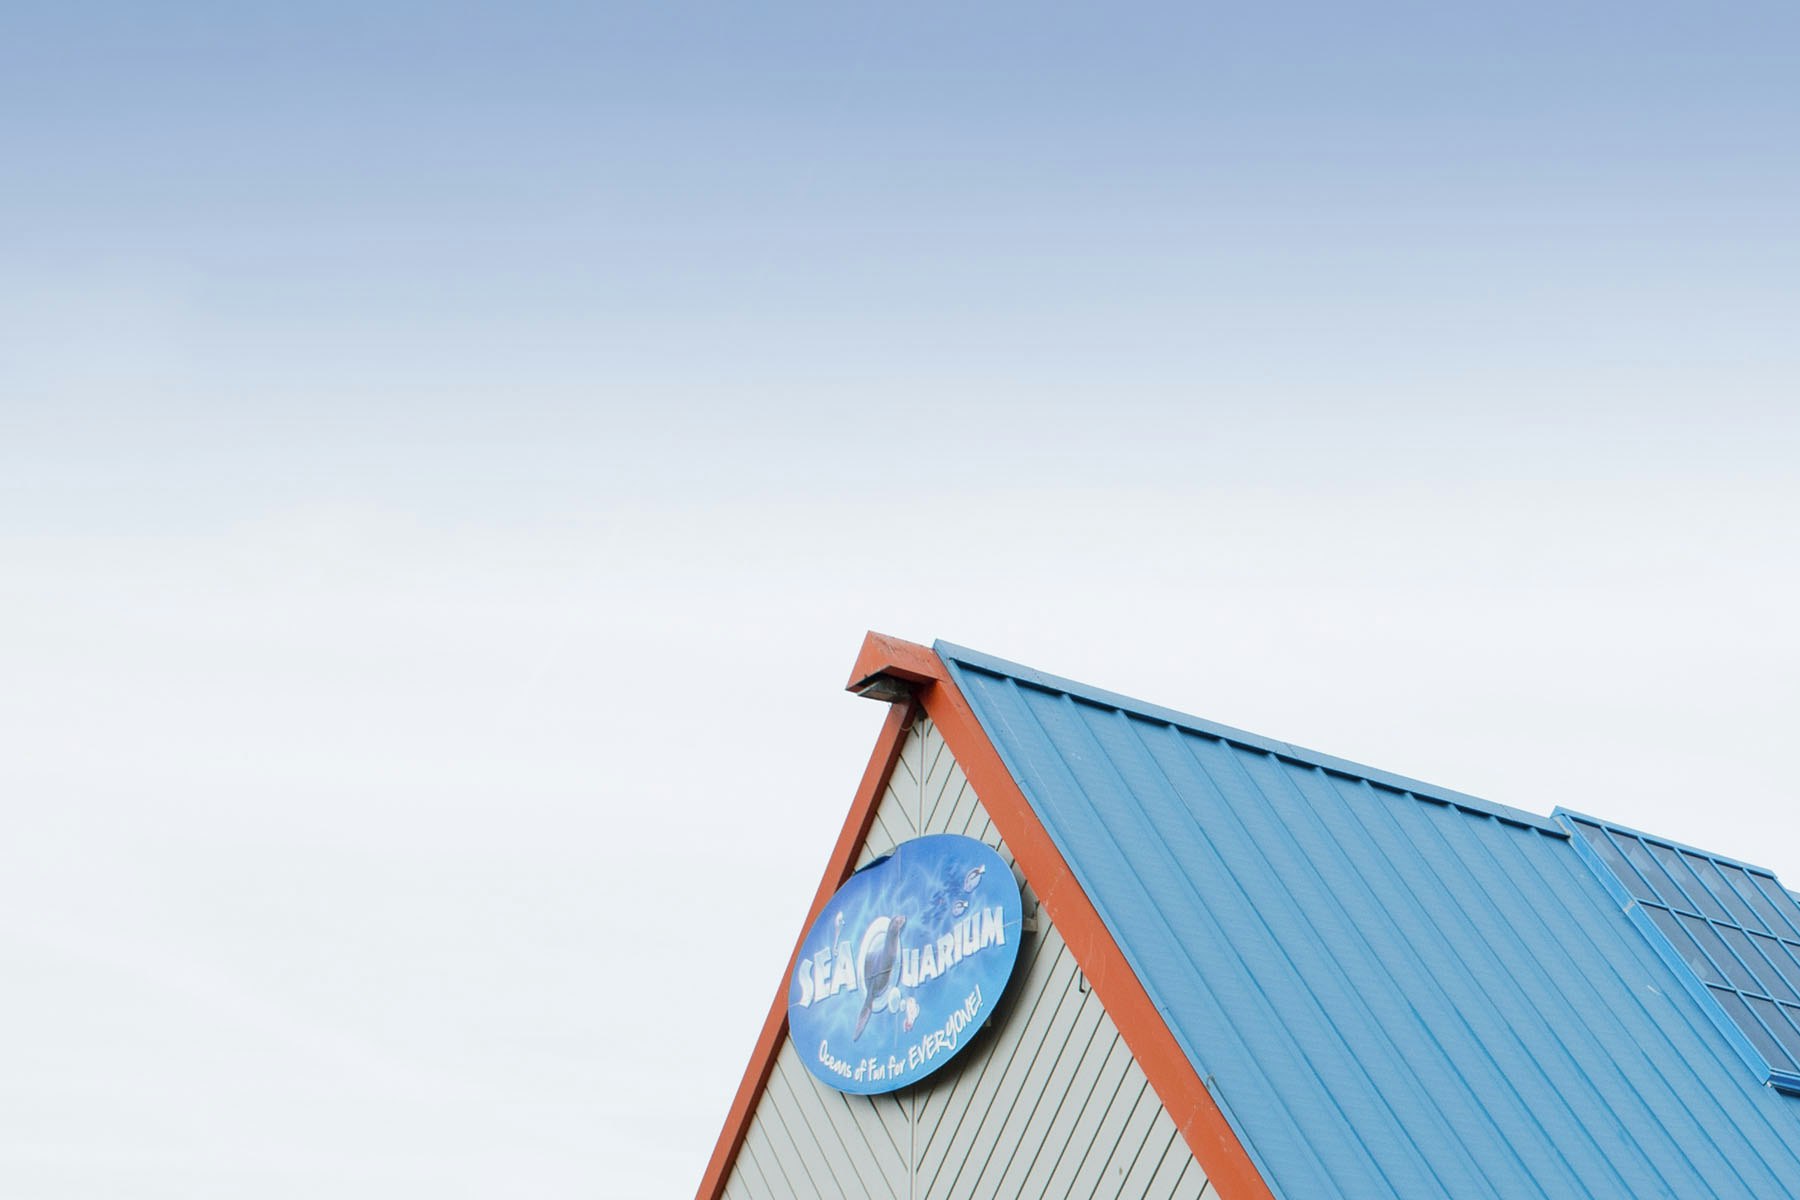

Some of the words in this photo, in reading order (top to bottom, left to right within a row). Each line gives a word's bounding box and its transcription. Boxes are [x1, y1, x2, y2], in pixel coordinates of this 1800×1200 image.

[818, 1039, 852, 1078] Oceans
[854, 1058, 868, 1082] of
[867, 1057, 885, 1081] Fun
[888, 1056, 905, 1080] for
[908, 983, 984, 1071] EVERYONE!
